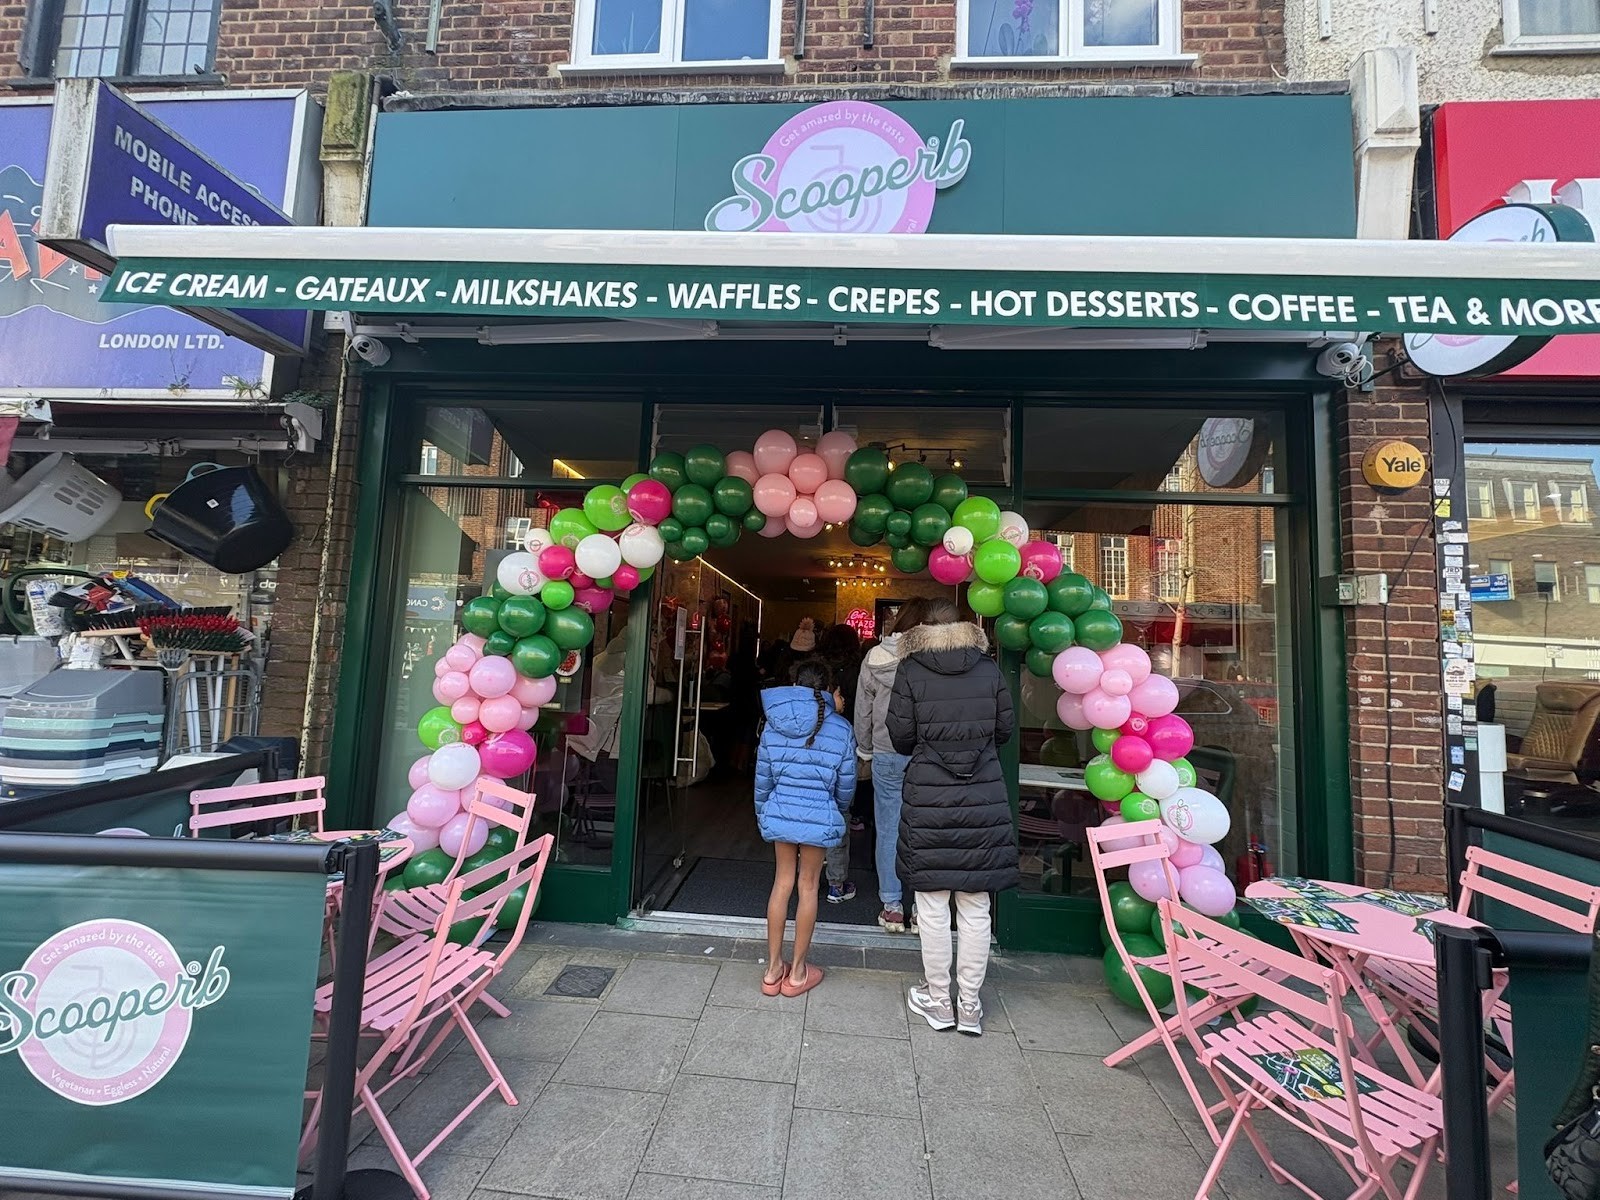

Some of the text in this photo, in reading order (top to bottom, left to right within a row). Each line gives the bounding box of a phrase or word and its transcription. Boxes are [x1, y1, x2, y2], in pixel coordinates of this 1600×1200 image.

[779, 108, 906, 147] Get amazed by the taste
[114, 125, 193, 195] MOBILE
[115, 270, 167, 294] ICE
[169, 273, 269, 299] CREAM
[295, 275, 431, 303] GATEAUX
[452, 278, 638, 309] MILKSHAKES
[667, 283, 801, 310] WAFFLES
[828, 286, 940, 315] CREPES
[970, 290, 1037, 317] HOT
[1047, 290, 1200, 318] DESSERTS
[1228, 293, 1358, 323] COFFEE
[1387, 296, 1457, 325] TEA
[1466, 297, 1492, 326] &
[98, 333, 225, 350] LONDON LTD.
[1382, 457, 1421, 473] Yale
[40, 928, 166, 969] Get amazed by the taste
[0, 946, 230, 1051] Scooperb
[51, 1046, 171, 1098] Vegetarian Eggless Natural
